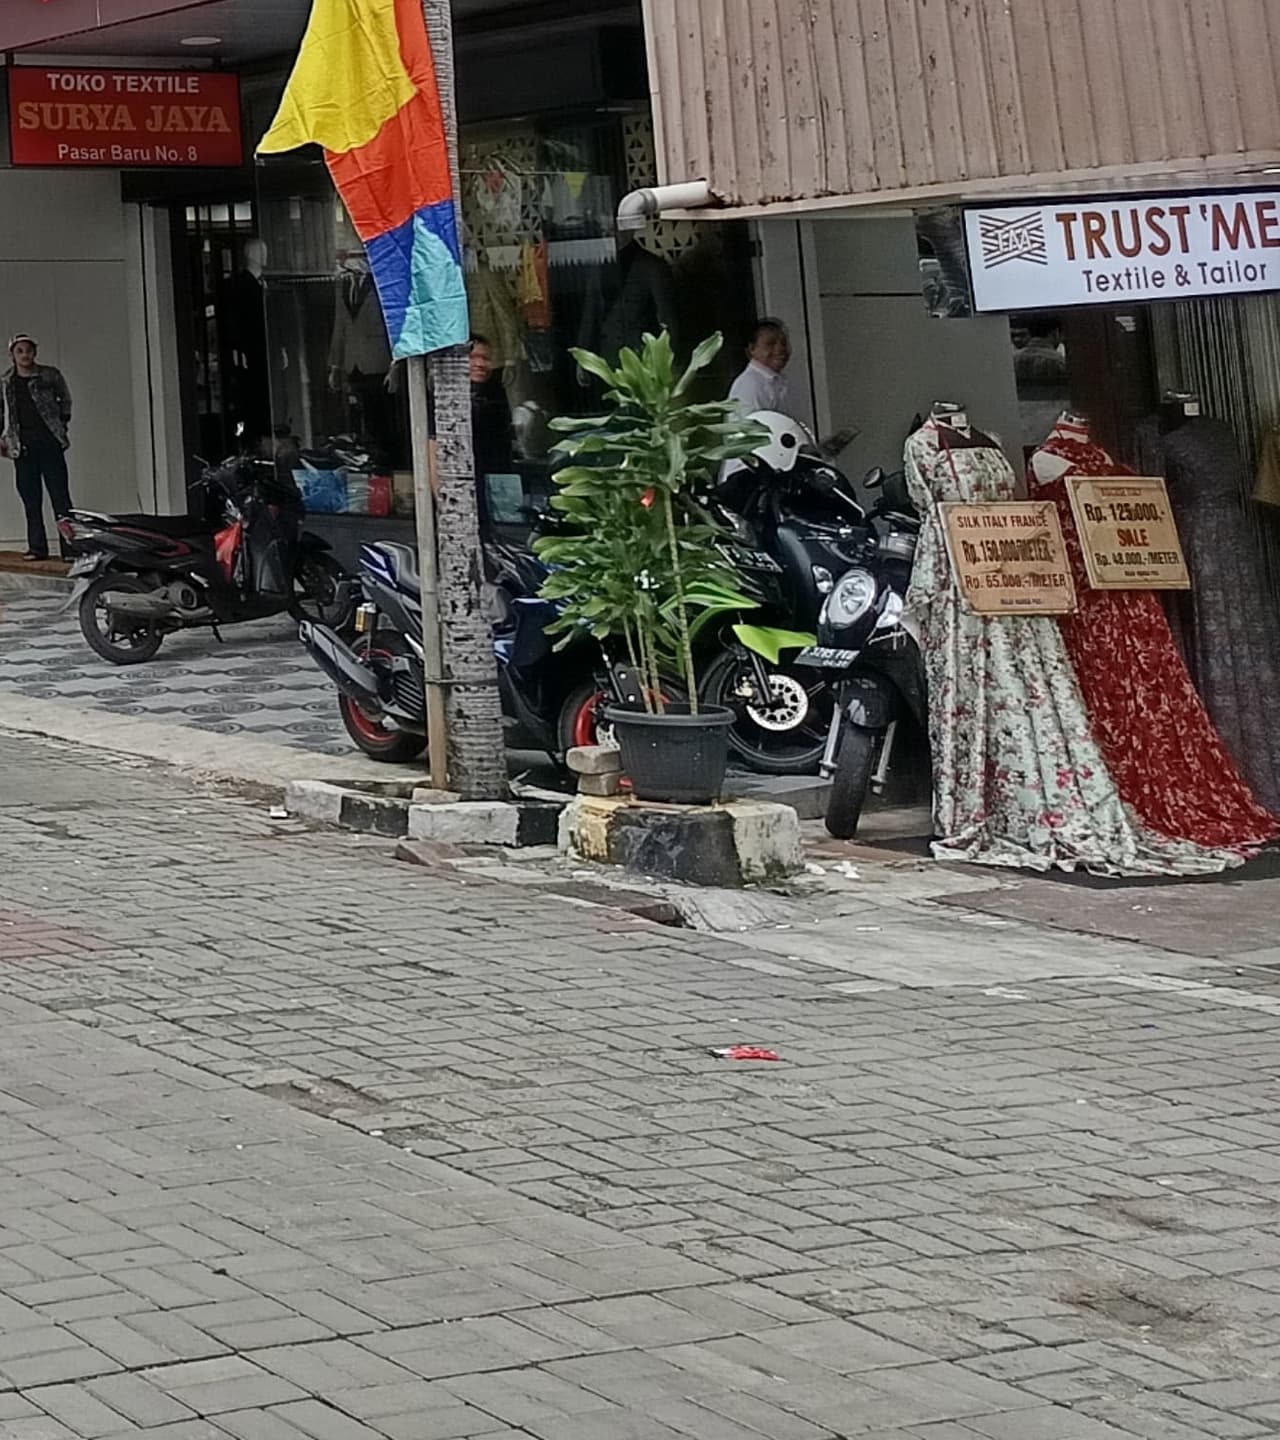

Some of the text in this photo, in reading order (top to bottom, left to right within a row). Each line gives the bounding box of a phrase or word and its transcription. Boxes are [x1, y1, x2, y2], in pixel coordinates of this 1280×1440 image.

[46, 73, 200, 94] TOKO TEXTILE
[18, 101, 232, 133] SURYA JAYA
[57, 144, 105, 160] Pasar
[111, 145, 151, 161] Baru
[155, 145, 184, 162] No.
[1082, 259, 1269, 294] Textile & Tailor
[957, 515, 1049, 528] SILK ITALY FRANCE
[1084, 503, 1108, 523] Rp.
[1117, 528, 1150, 547] SALE
